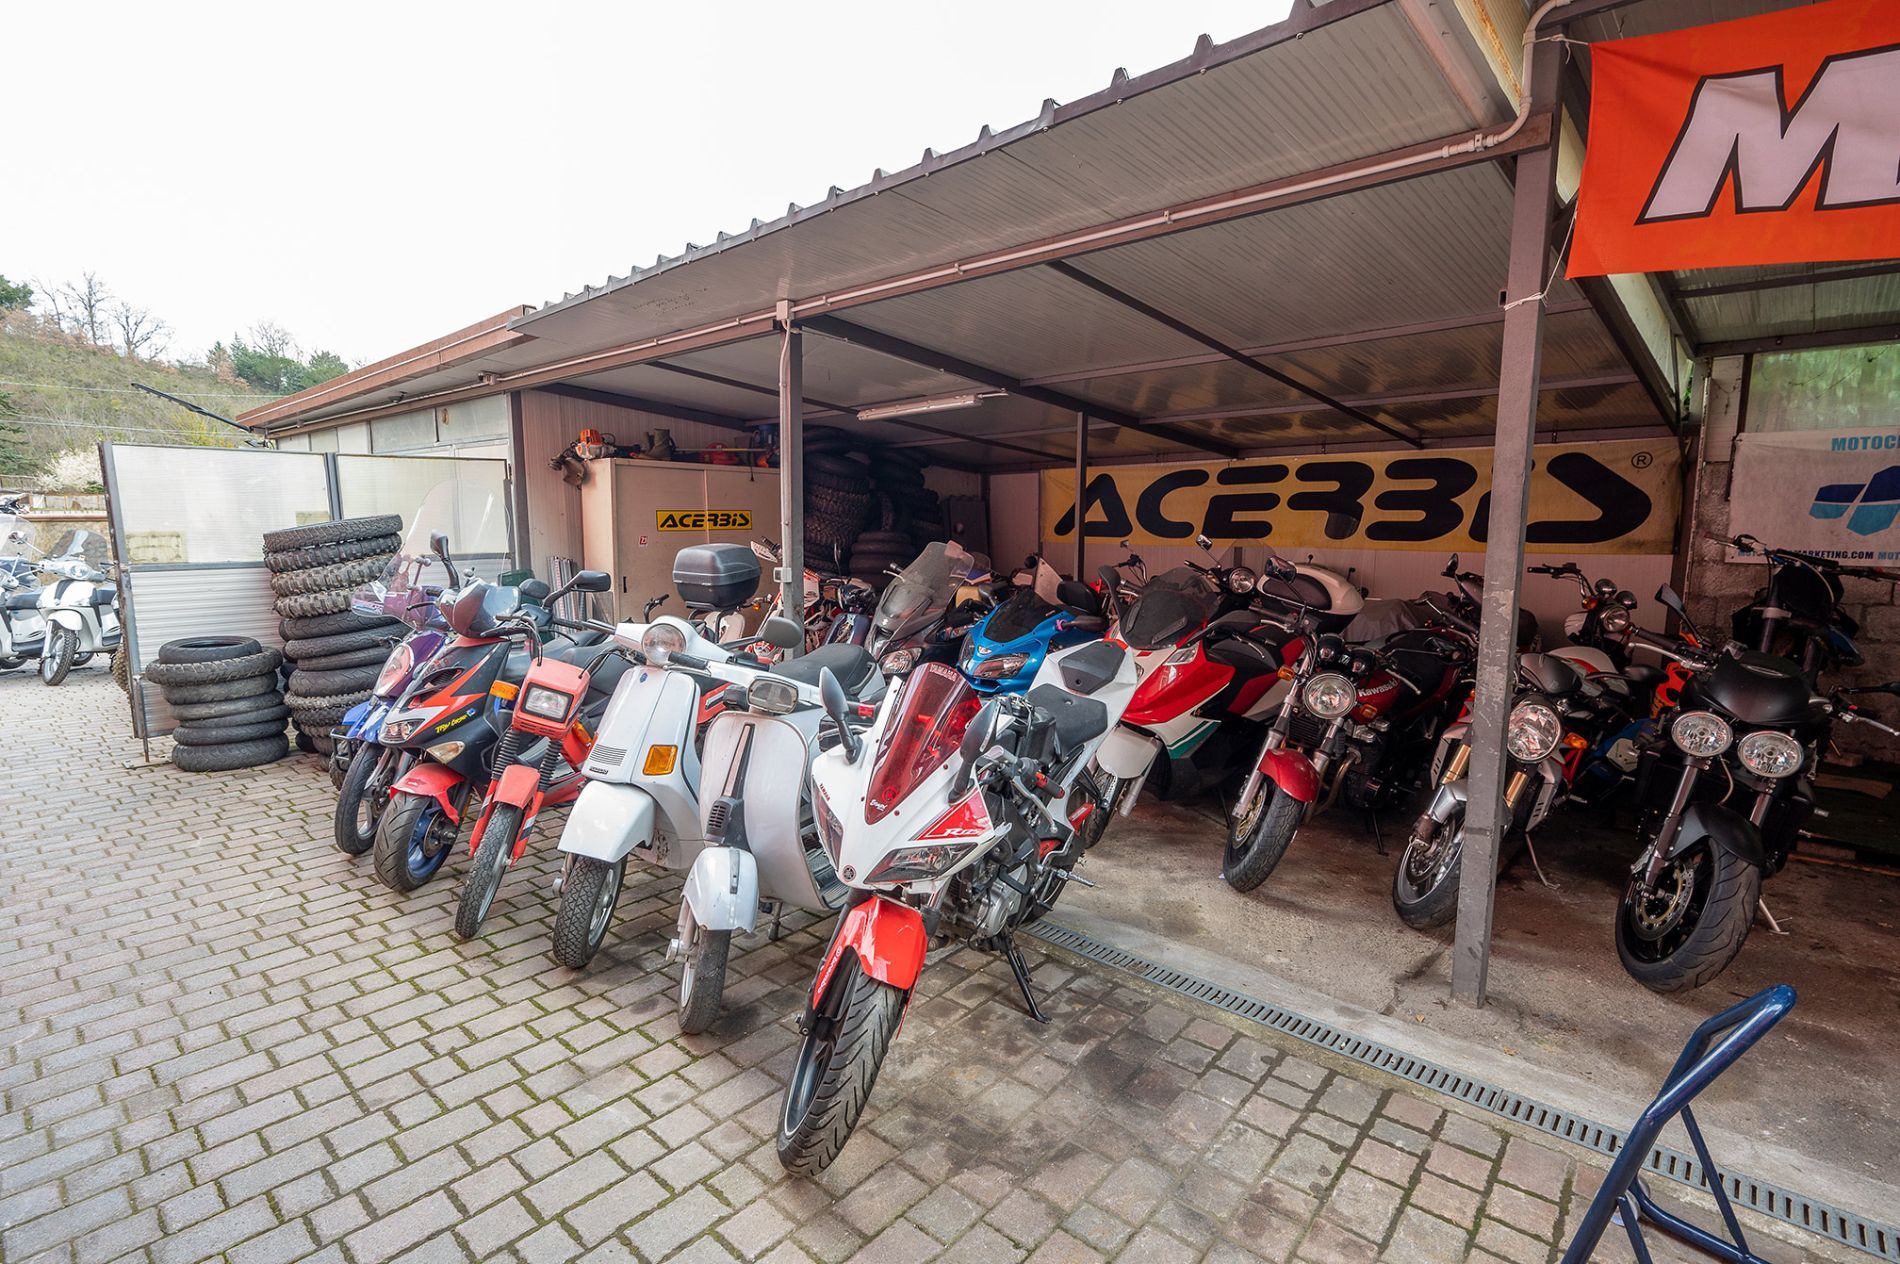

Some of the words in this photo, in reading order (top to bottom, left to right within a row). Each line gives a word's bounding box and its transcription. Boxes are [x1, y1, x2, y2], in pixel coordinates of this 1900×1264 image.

[1831, 434, 1900, 451] MOTOC
[1795, 550, 1874, 560] ARKETING.COM
[1358, 678, 1398, 697] Kawasaki
